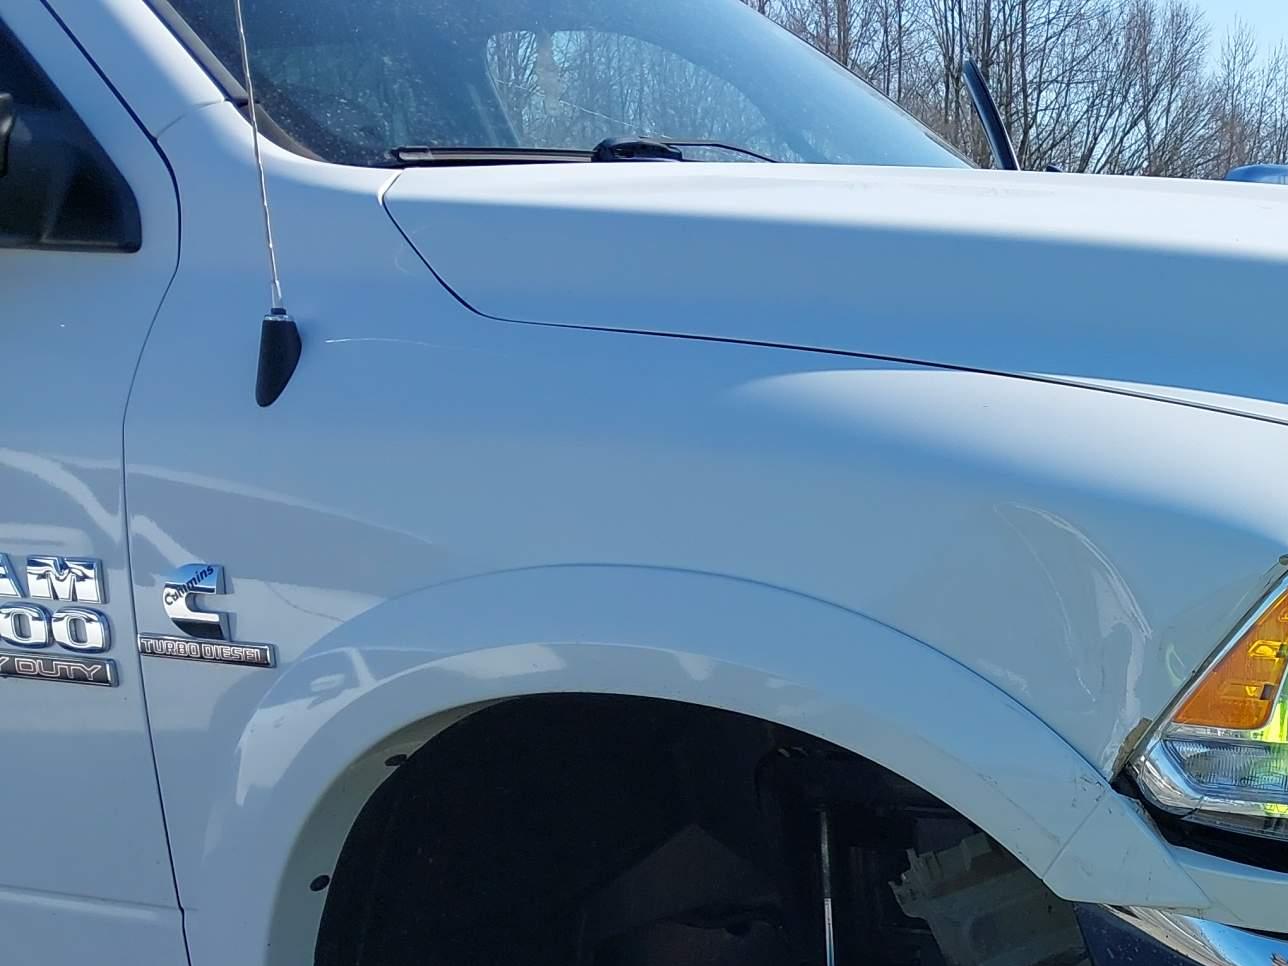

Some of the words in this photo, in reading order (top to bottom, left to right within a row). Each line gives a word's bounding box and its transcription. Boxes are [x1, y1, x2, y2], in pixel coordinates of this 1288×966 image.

[164, 564, 215, 606] Cummins
[141, 639, 200, 658] TURBO
[201, 643, 261, 662] DIESEL
[15, 657, 102, 680] DUTY
